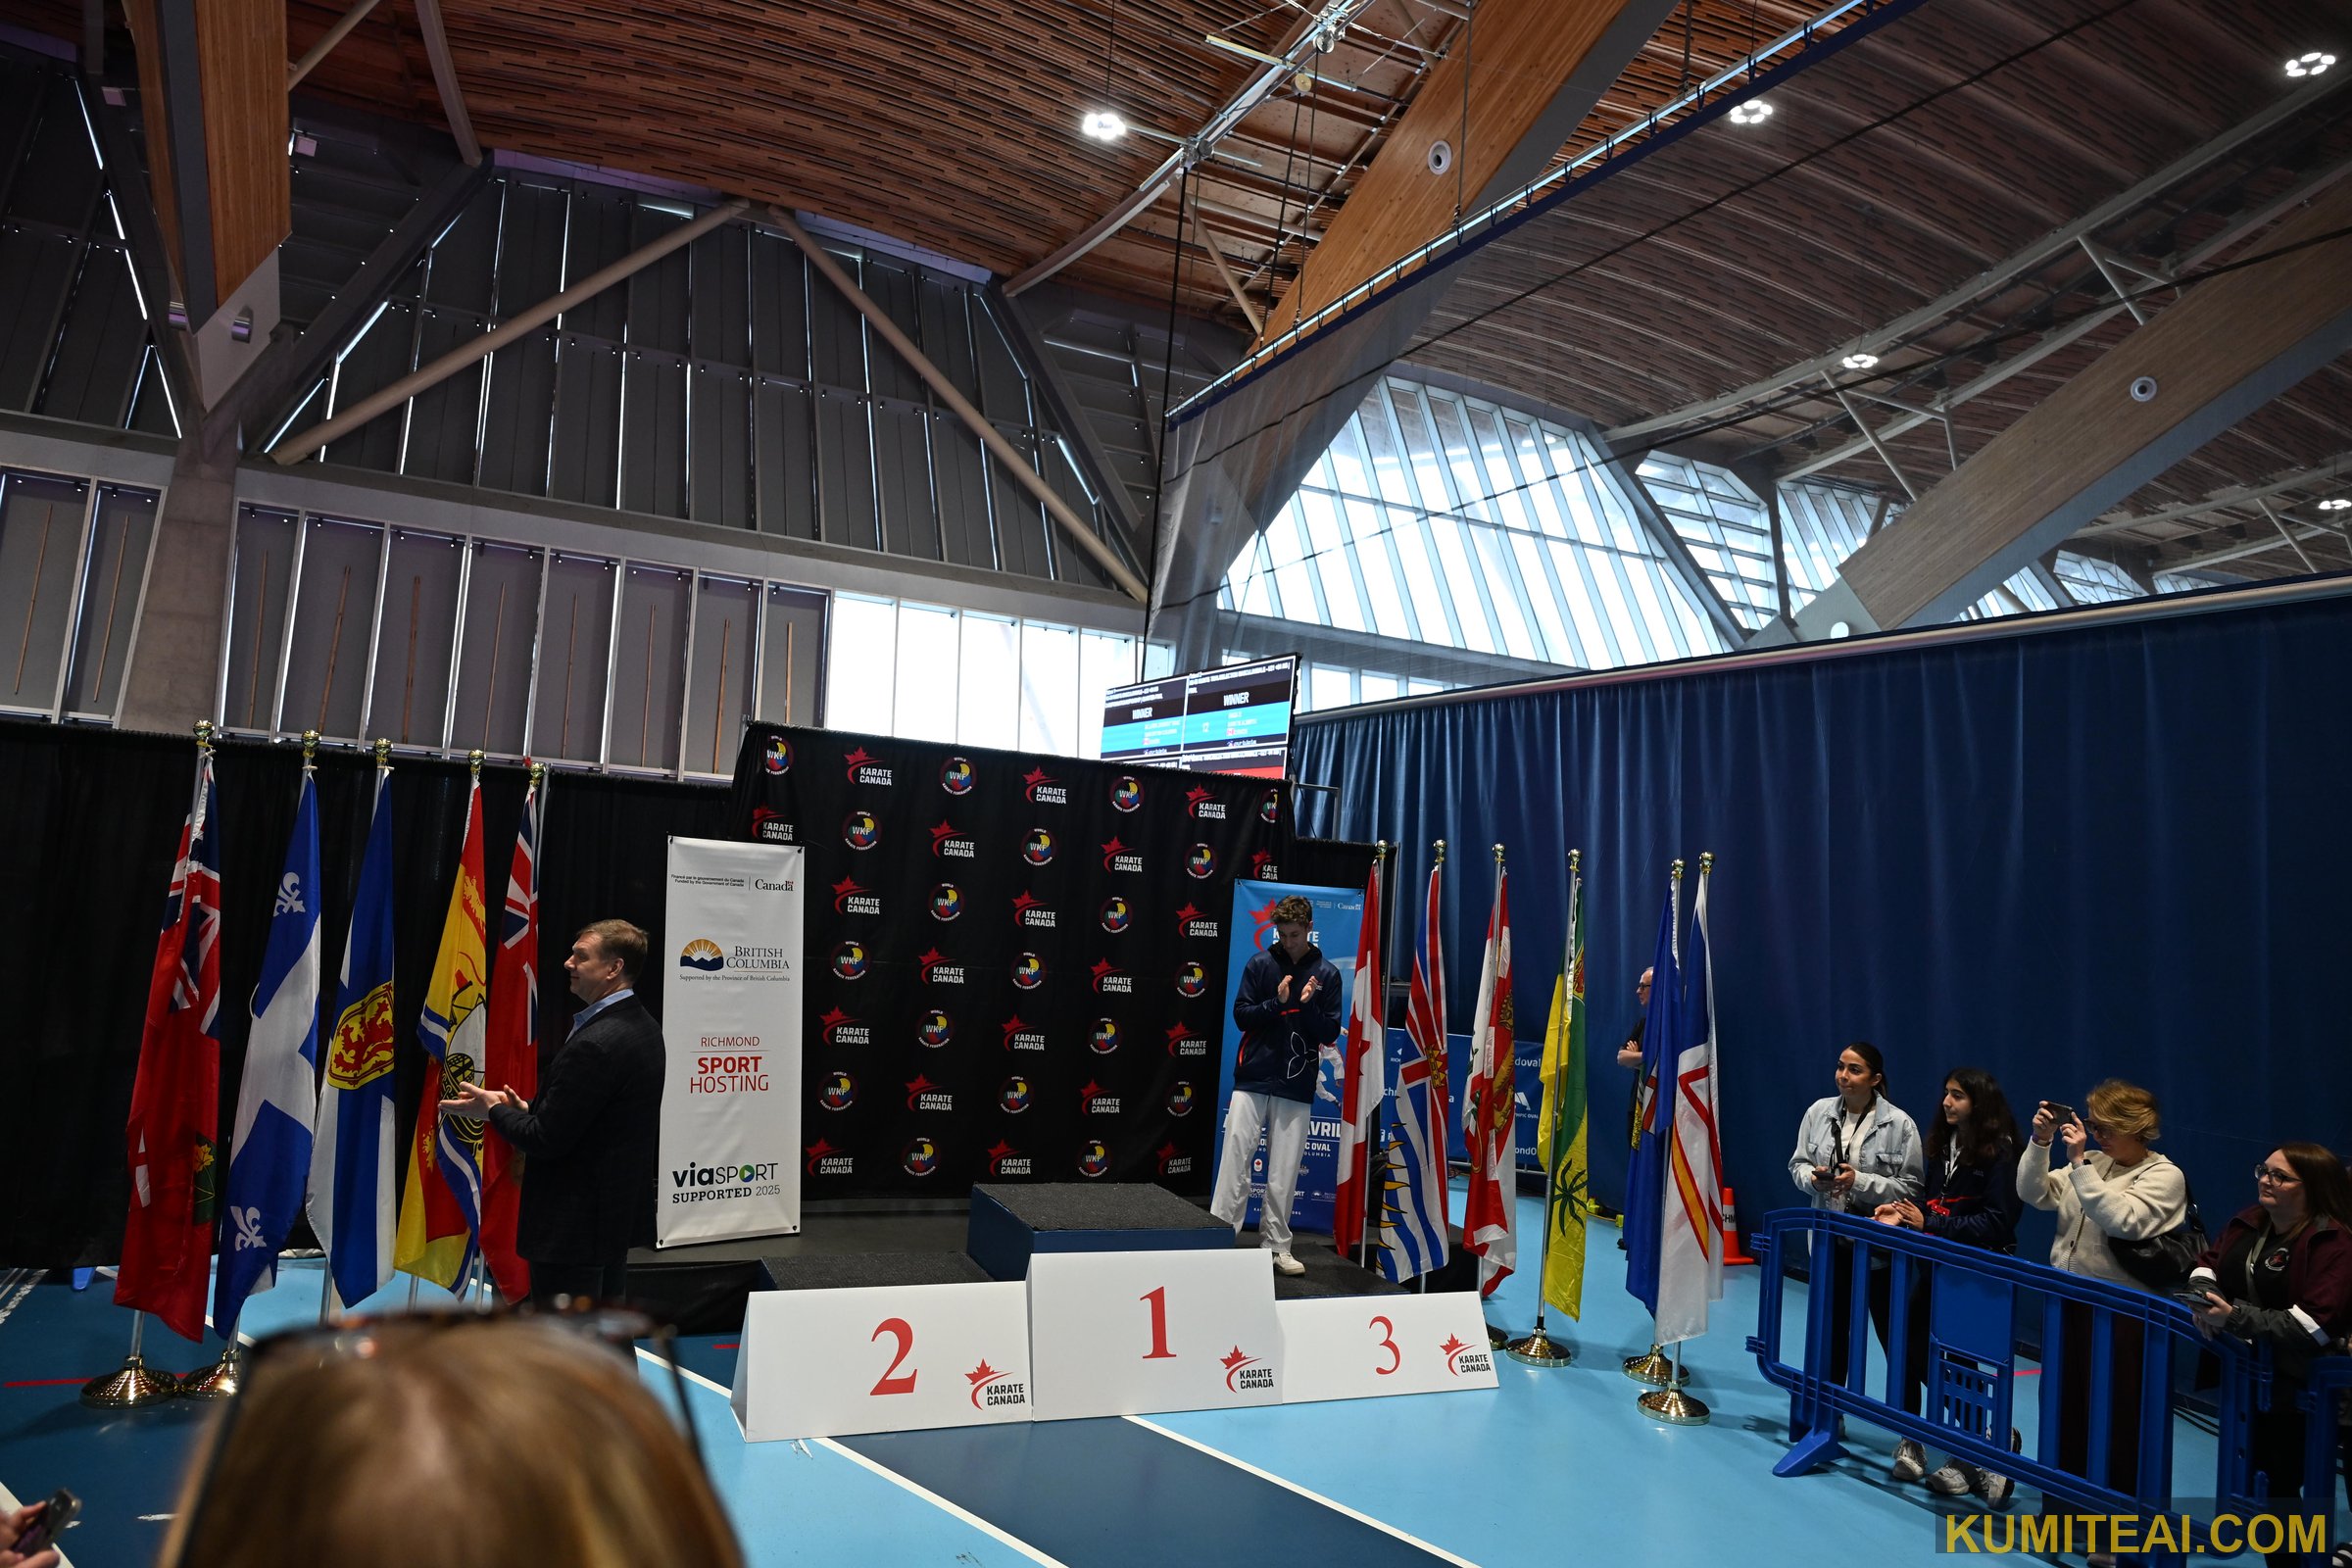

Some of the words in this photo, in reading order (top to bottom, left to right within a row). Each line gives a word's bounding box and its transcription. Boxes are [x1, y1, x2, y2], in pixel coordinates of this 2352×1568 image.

[767, 750, 783, 760] WKF
[860, 767, 893, 778] KARATE
[860, 775, 892, 786] CANADA
[1037, 786, 1067, 797] KARATE
[1119, 790, 1135, 799] WKF
[1037, 794, 1067, 805] CANADA
[1200, 803, 1226, 812] KARATE
[1199, 810, 1226, 819] CANADA
[763, 822, 793, 833] KARATE
[763, 831, 793, 841] CANADA
[945, 841, 975, 851] KARATE
[945, 849, 975, 858] CANADA
[1115, 857, 1143, 865] KARATE
[1115, 863, 1143, 872] CANADA
[755, 879, 794, 892] Canada
[849, 897, 880, 906] KARATE
[848, 905, 880, 914] CANADA
[1026, 910, 1056, 920] KARATE
[1025, 918, 1055, 928] CANADA
[1191, 921, 1218, 930] KARATE
[1190, 929, 1218, 938] CANADA
[735, 946, 783, 957] BRITISH
[726, 956, 790, 969] COLUMBIA
[934, 967, 964, 976] KARATE
[933, 975, 964, 984] CANADA
[1103, 977, 1132, 986] KARATE
[837, 1027, 870, 1037] KARATE
[701, 1036, 760, 1048] RICHMOND
[836, 1035, 869, 1045] CANADA
[1015, 1034, 1046, 1044] KARATE
[1014, 1042, 1045, 1051] CANADA
[698, 1056, 762, 1074] SPORT
[690, 1074, 769, 1094] HOSTING
[921, 1095, 953, 1103] KARATE
[920, 1102, 953, 1111] CANADA
[1307, 1121, 1341, 1137] VRIL
[1311, 1143, 1331, 1152] OVAL
[1169, 1157, 1192, 1167] KARATE
[1168, 1165, 1191, 1174] CANADA
[672, 1187, 752, 1203] SUPPORTED
[756, 1185, 780, 1197] 2025
[1140, 1287, 1177, 1359] 1
[1369, 1315, 1401, 1375] 3
[870, 1317, 918, 1396] 2
[1459, 1354, 1488, 1363] KARATE
[1460, 1363, 1491, 1373] CANADA
[1240, 1369, 1272, 1379] KARATE
[1240, 1379, 1274, 1389] CANADA
[987, 1384, 1024, 1395] KARATE
[987, 1395, 1025, 1405] CANADA
